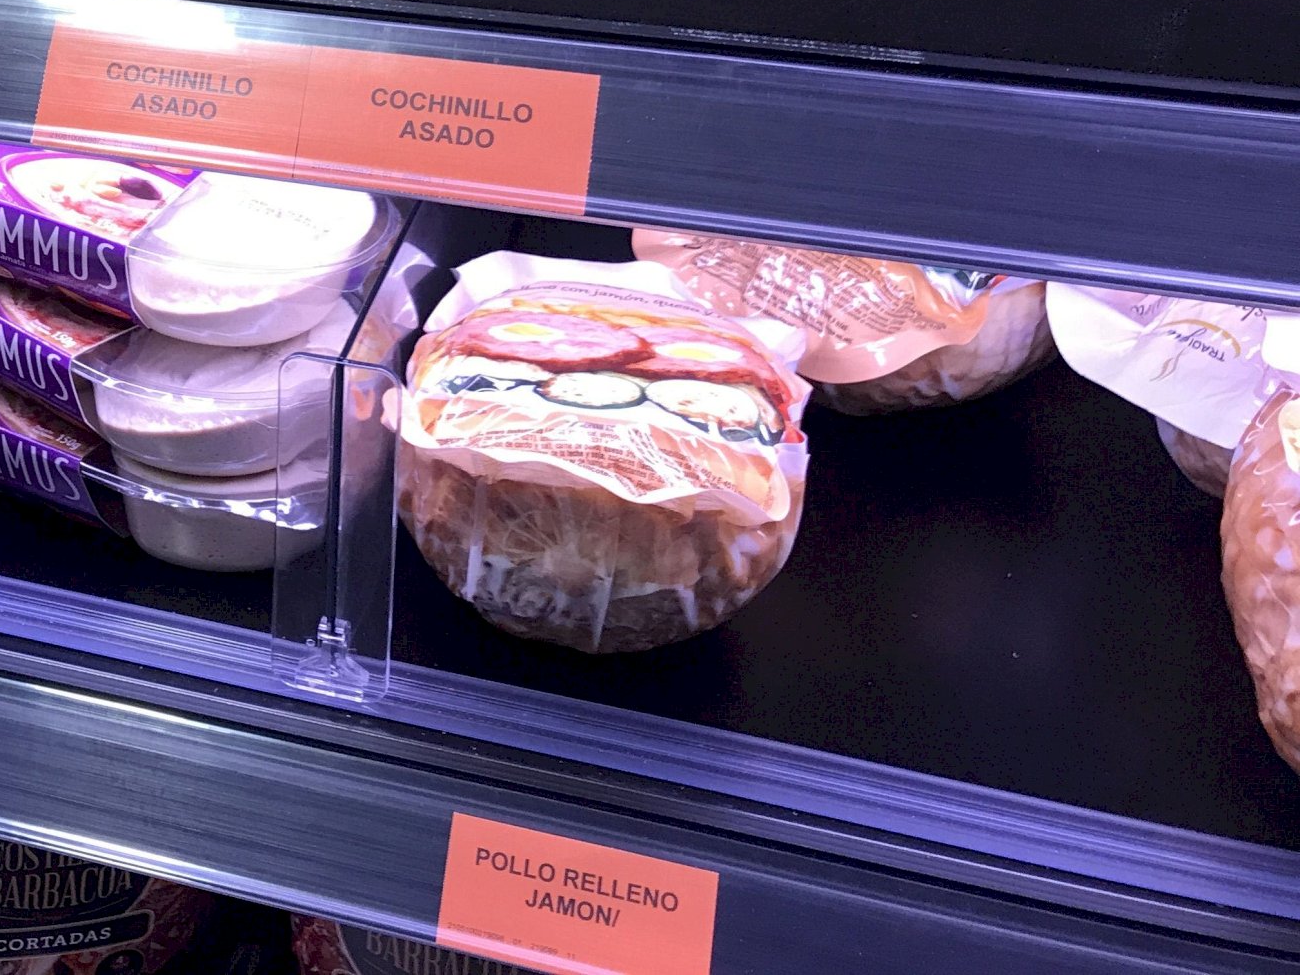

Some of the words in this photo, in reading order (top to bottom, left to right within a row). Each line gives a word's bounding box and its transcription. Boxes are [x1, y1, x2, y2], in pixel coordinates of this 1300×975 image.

[106, 60, 254, 97] COCHINILLO
[130, 92, 218, 121] ASADO
[370, 86, 534, 124] COCHINILLO
[399, 119, 495, 150] ASADO
[49, 329, 76, 350] 150g
[55, 433, 82, 451] 150g
[474, 846, 556, 884] POLLO
[564, 868, 679, 913] RELLENO
[525, 887, 621, 929] JAMON/
